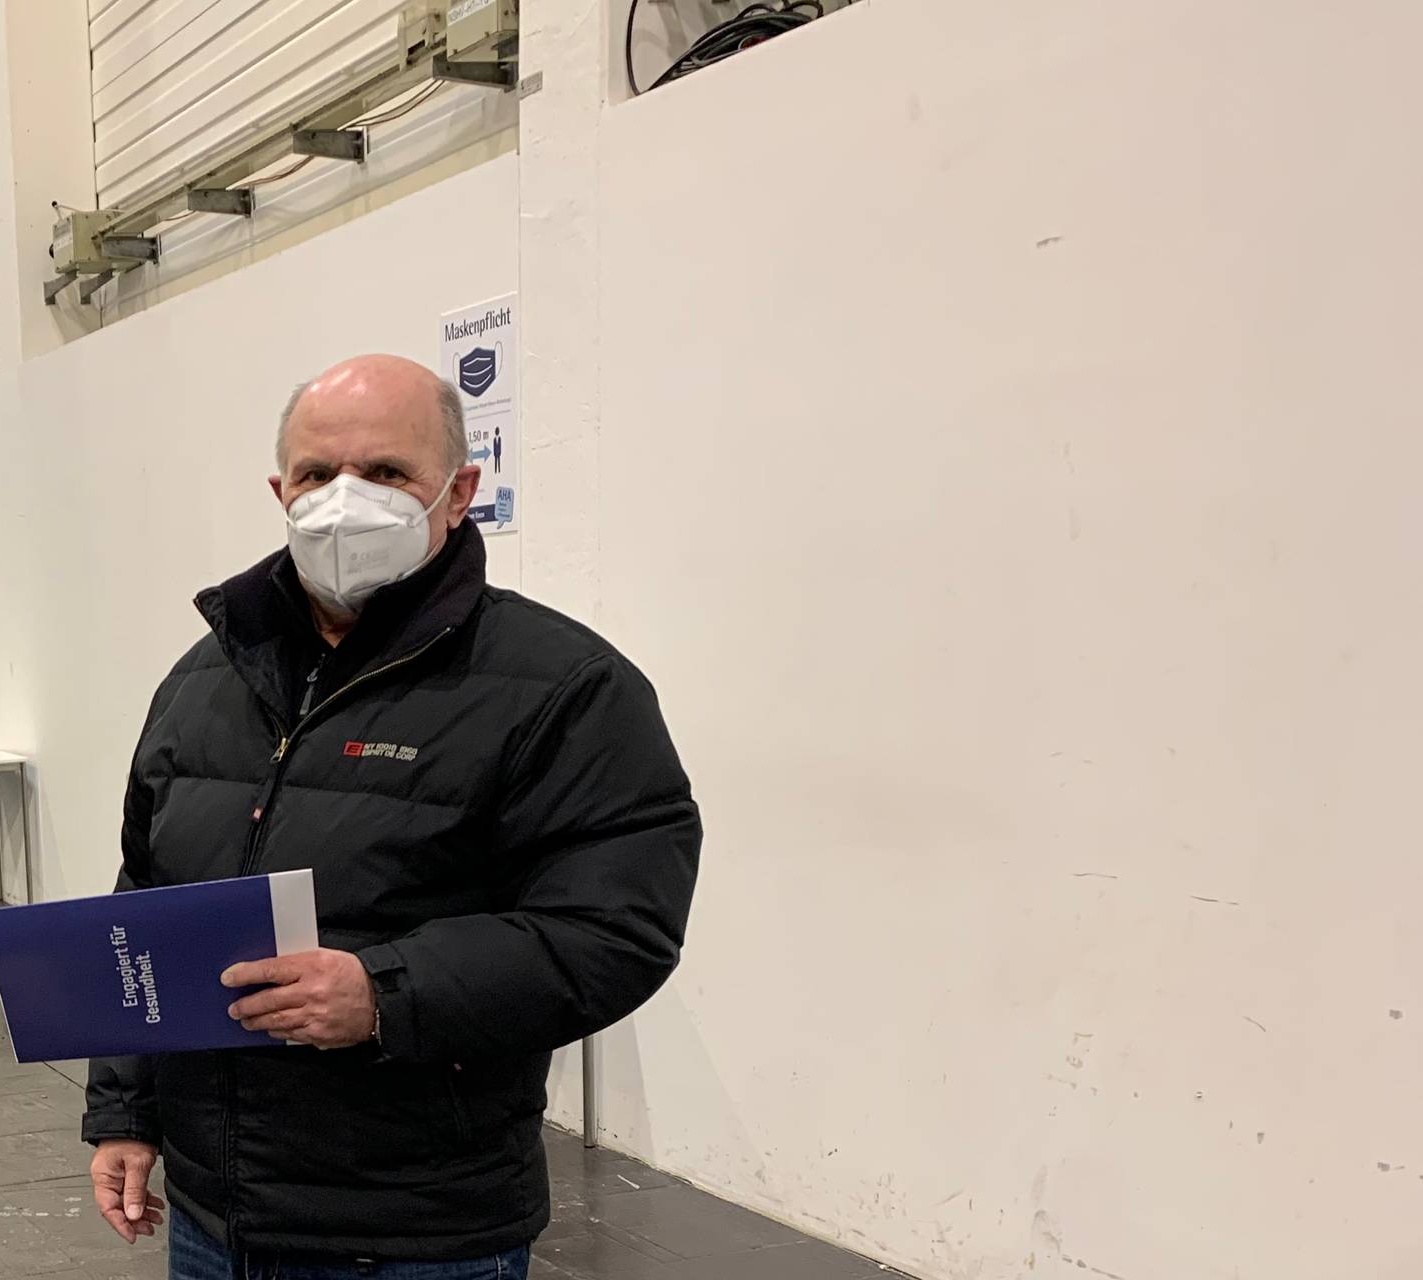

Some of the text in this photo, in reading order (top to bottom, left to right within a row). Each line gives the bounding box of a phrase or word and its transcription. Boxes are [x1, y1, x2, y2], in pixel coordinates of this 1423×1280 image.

[445, 307, 511, 342] Maskenpflicht
[110, 925, 139, 1007] Engagiert für
[135, 950, 161, 1023] Gesundheit.
